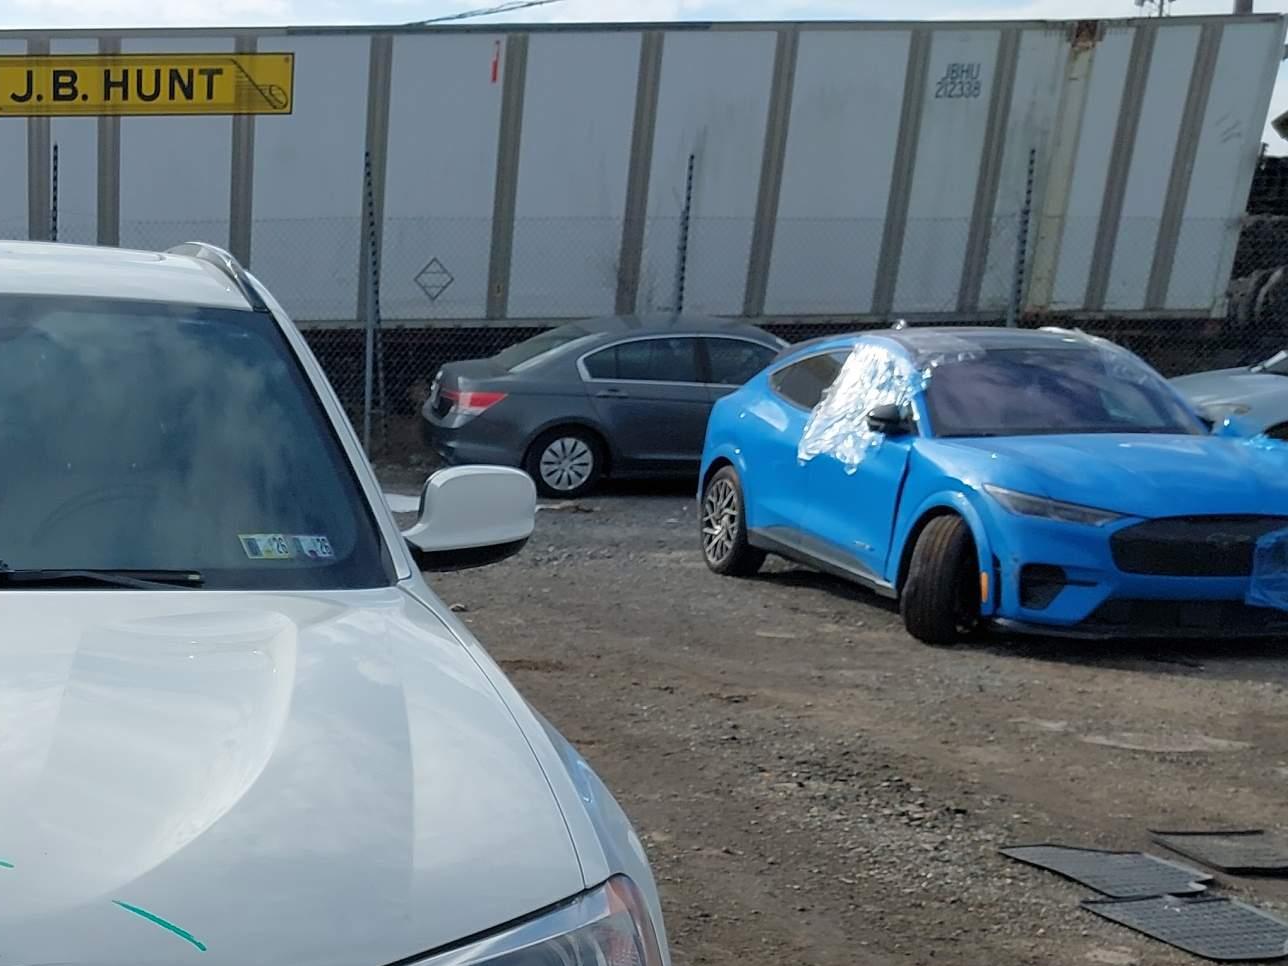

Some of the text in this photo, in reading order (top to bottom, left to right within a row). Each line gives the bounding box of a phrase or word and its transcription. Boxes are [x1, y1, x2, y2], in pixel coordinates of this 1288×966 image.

[10, 68, 223, 102] J.B. HUNT
[941, 63, 981, 81] JBHU
